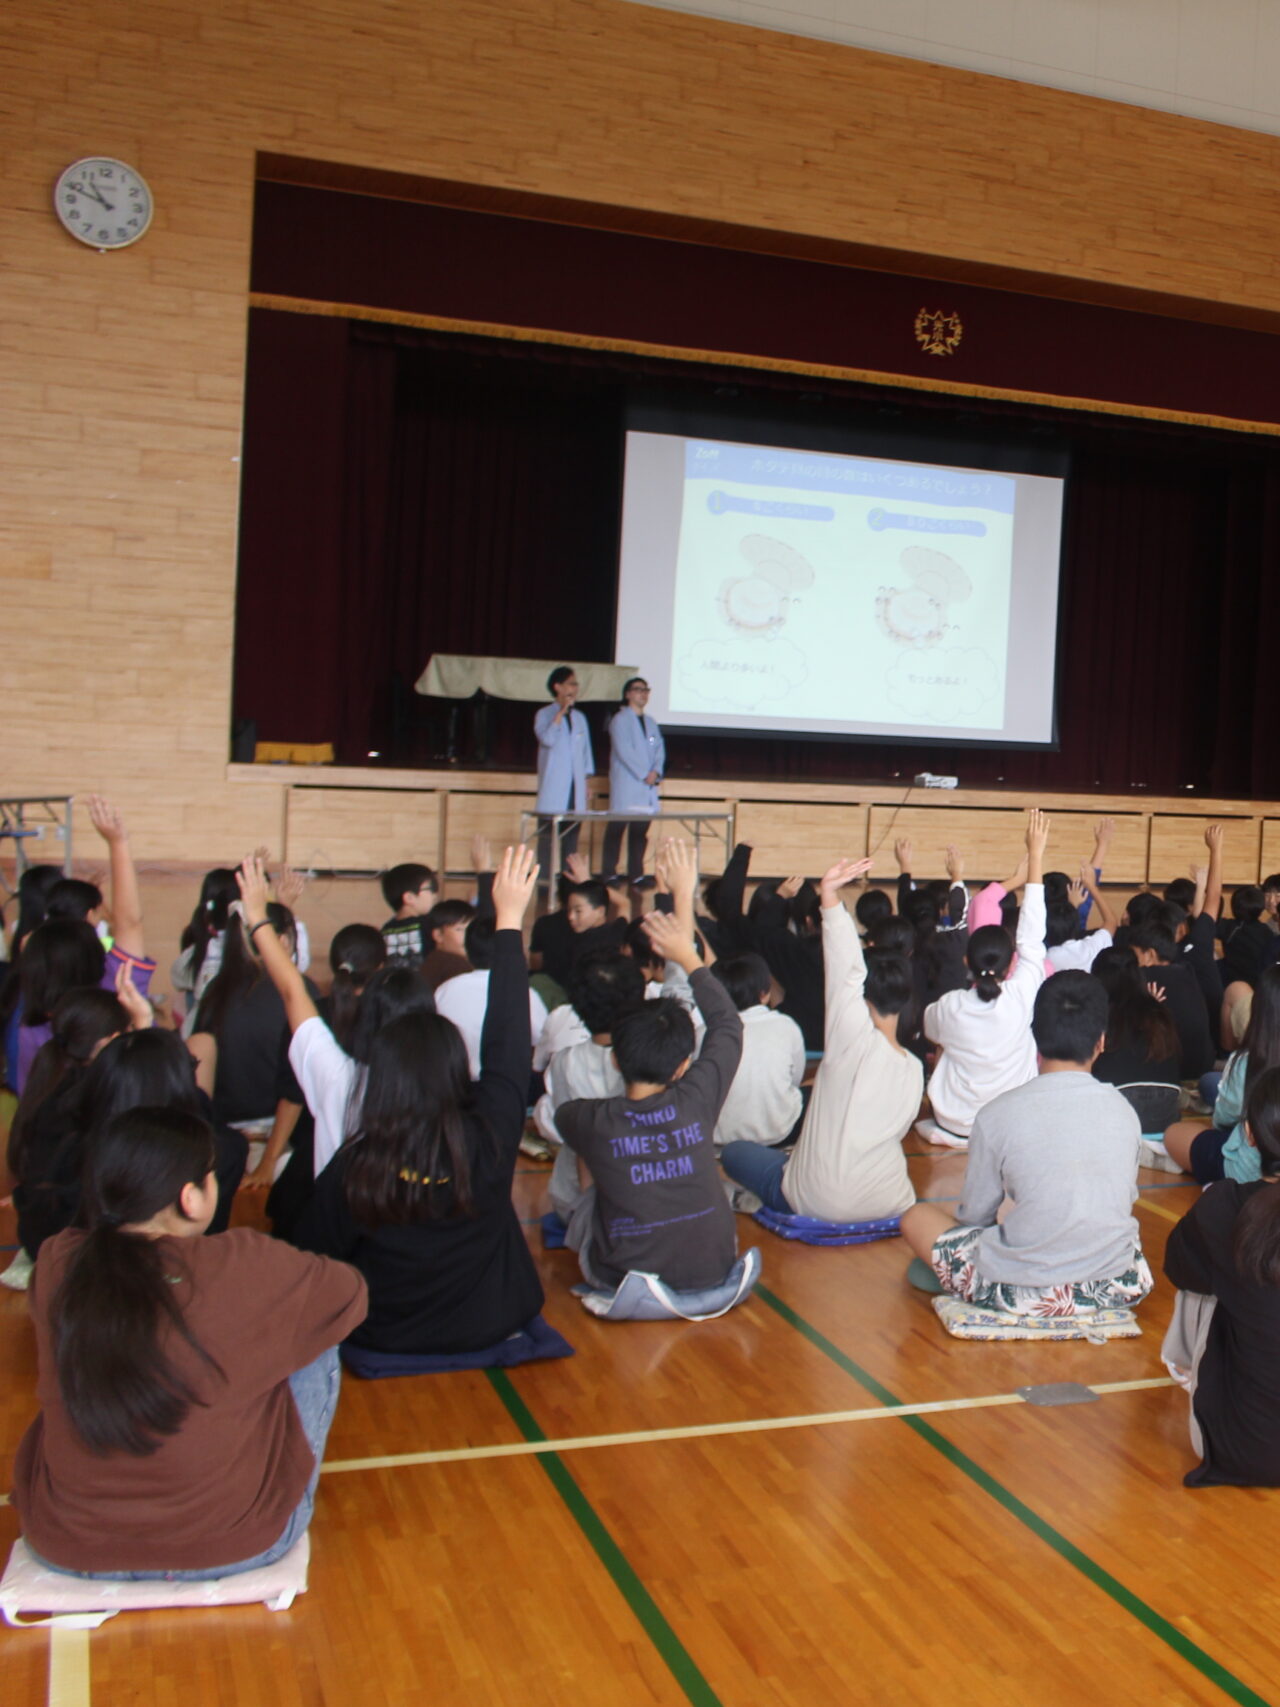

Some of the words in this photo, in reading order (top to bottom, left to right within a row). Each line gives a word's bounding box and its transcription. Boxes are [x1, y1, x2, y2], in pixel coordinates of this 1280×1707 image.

[100, 168, 112, 178] 12
[128, 188, 140, 198] 2
[133, 203, 144, 214] 3
[82, 222, 93, 233] 7
[127, 218, 138, 227] 4
[98, 230, 110, 240] 6
[116, 228, 128, 238] 5
[712, 494, 722, 511] 1
[871, 510, 883, 528] 2
[609, 1133, 669, 1158] TIME'S
[672, 1122, 704, 1150] THE
[630, 1154, 694, 1185] CHARM
